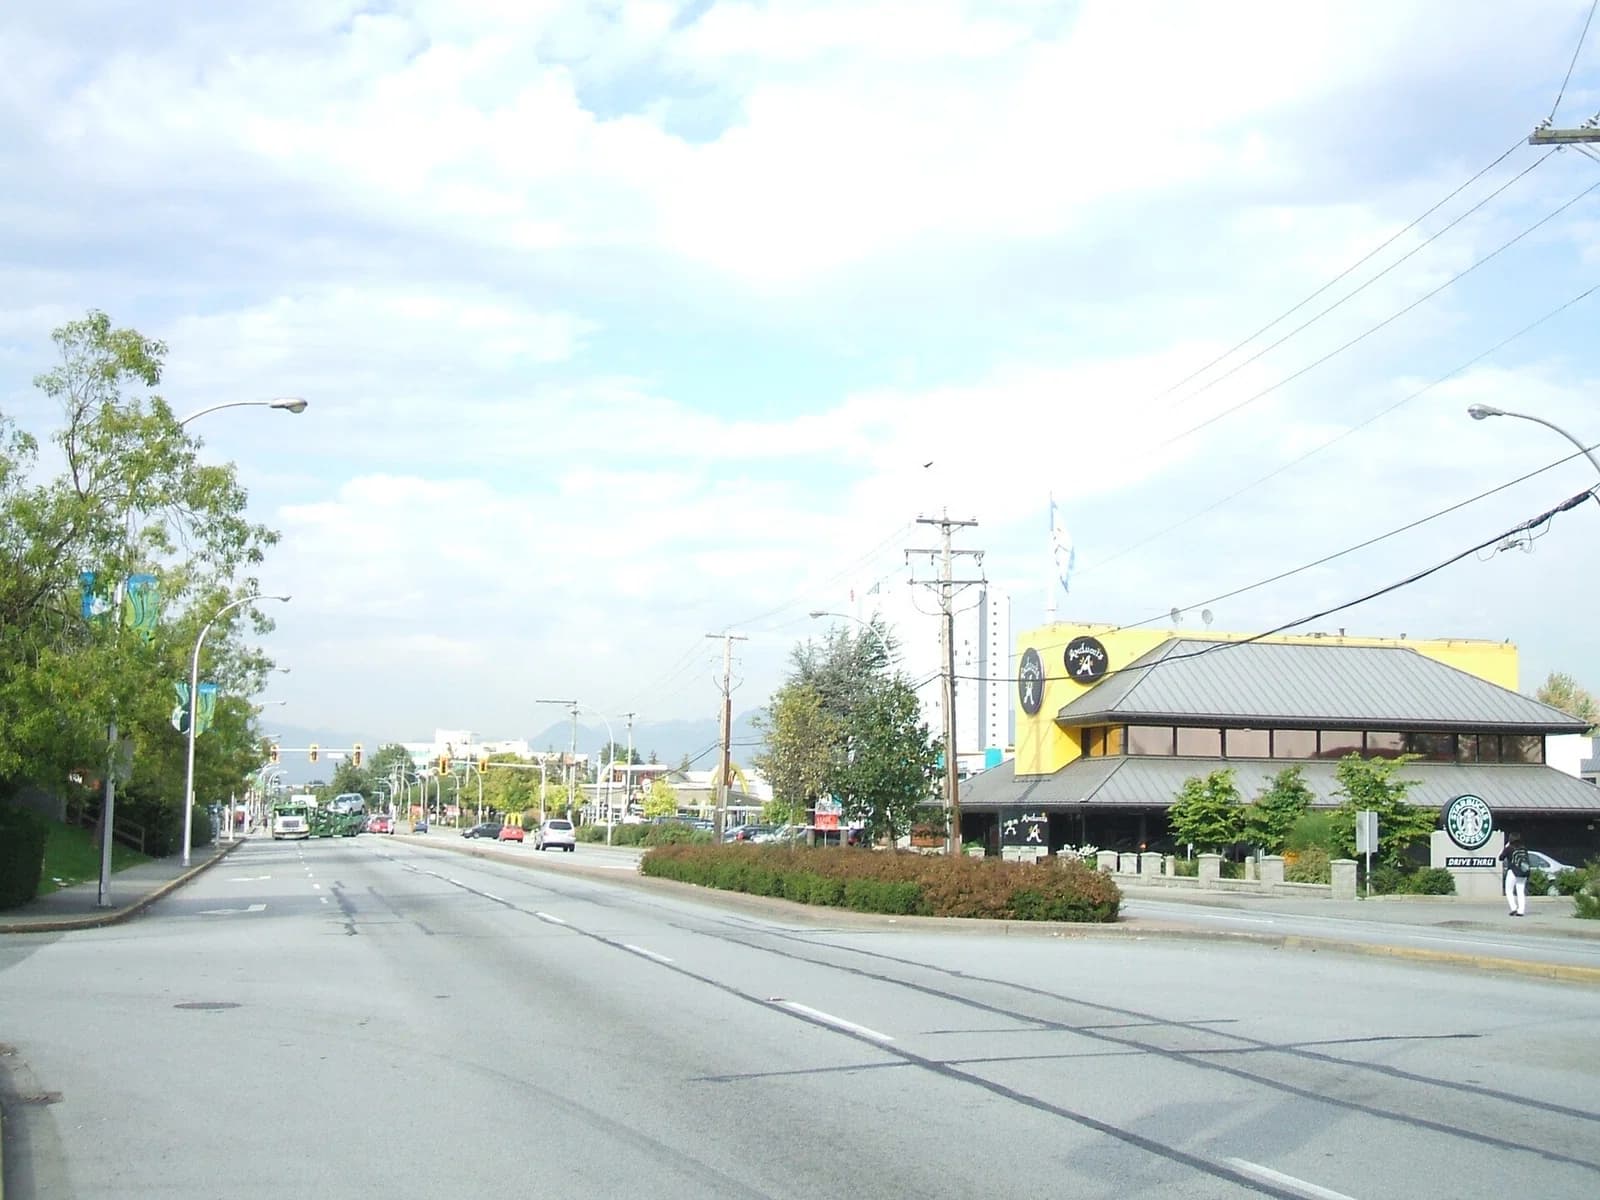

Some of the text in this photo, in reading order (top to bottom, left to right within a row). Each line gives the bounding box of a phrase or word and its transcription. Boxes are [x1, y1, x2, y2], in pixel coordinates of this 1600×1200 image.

[1451, 798, 1489, 820] STARBUCKS
[1455, 830, 1485, 844] COFFEE
[1448, 858, 1494, 866] DRIVE THRU
